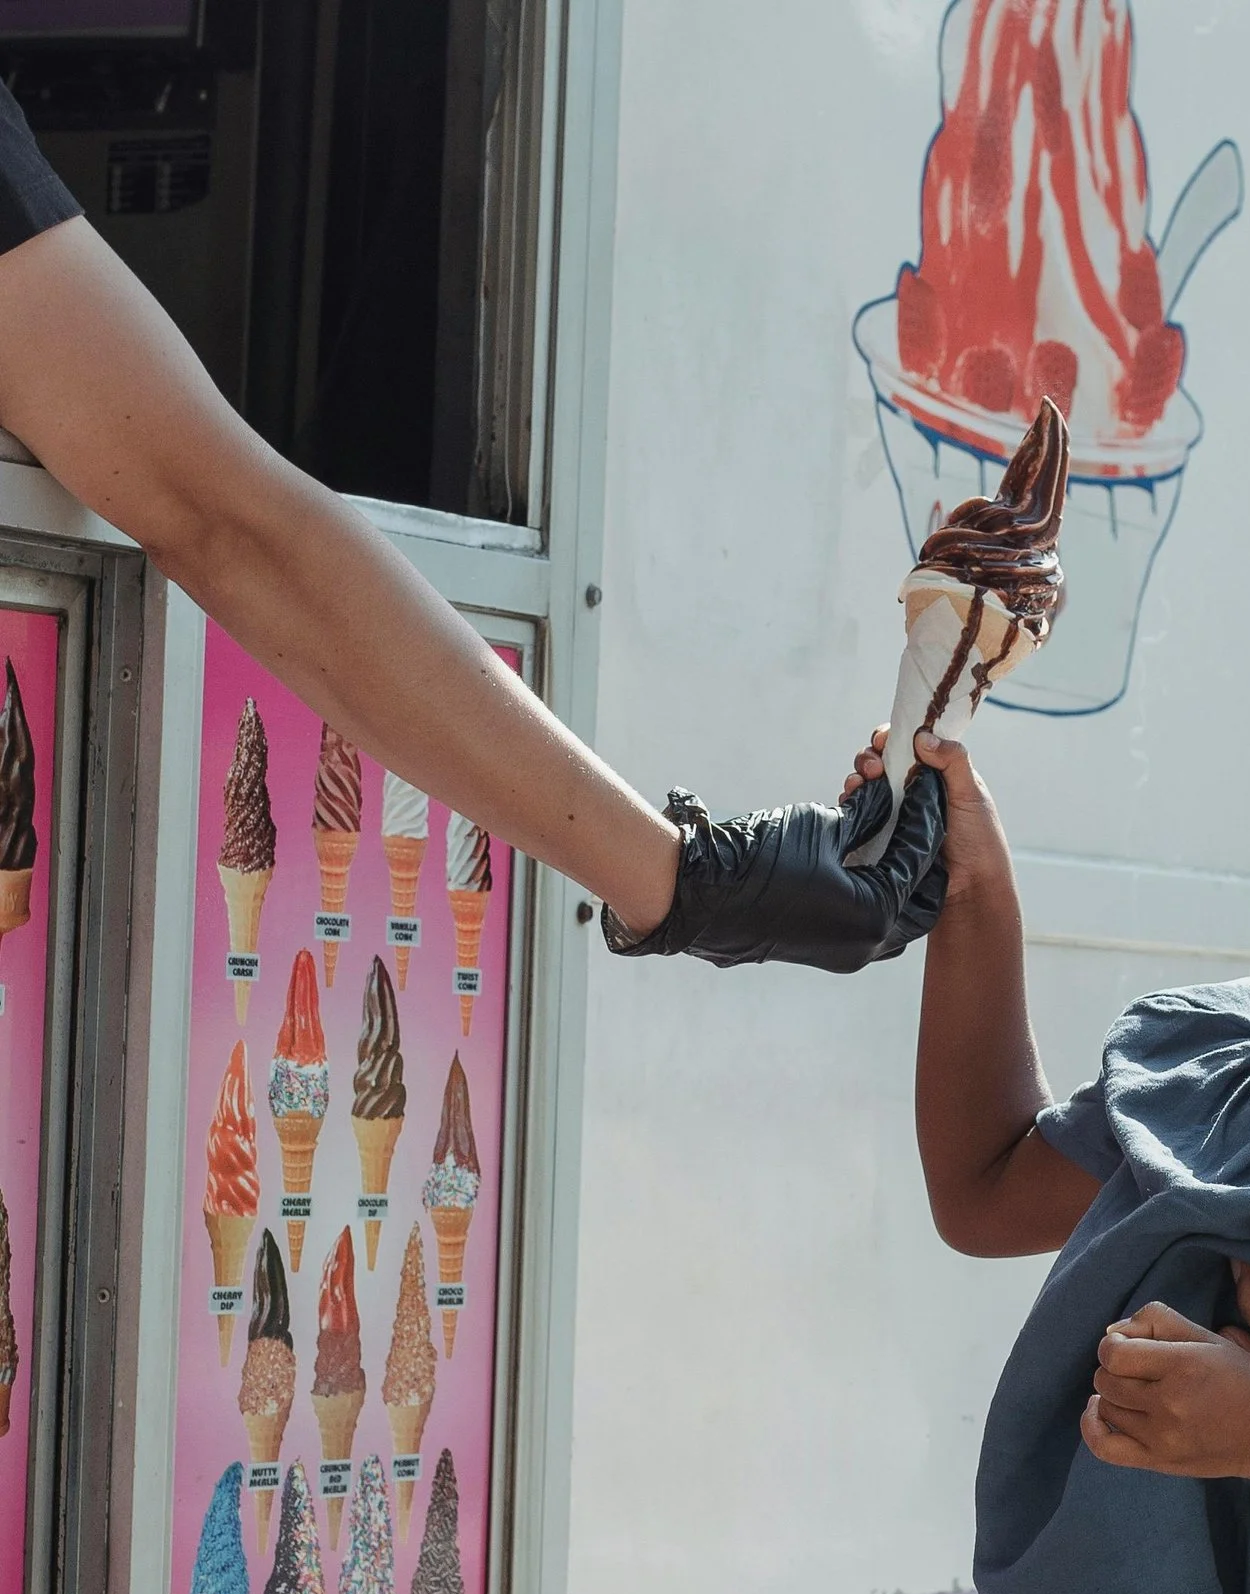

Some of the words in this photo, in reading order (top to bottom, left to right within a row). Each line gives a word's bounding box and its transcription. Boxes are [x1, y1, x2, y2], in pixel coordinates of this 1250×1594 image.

[390, 922, 418, 932] VANILLA
[324, 928, 340, 936] CONE
[394, 932, 413, 942] CONE
[457, 972, 478, 981] TWIST
[458, 982, 477, 991] CONE
[282, 1198, 312, 1207] CHERRY
[282, 1208, 310, 1217] MERLIN
[368, 1208, 378, 1217] DIP
[212, 1291, 243, 1300] CHERRY
[438, 1288, 464, 1296] CHOCO
[437, 1296, 464, 1306] MERLIN
[220, 1302, 234, 1310] DIP
[252, 1467, 278, 1477] NUTTY
[397, 1469, 416, 1478] CONE
[249, 1478, 279, 1487] MERLIN
